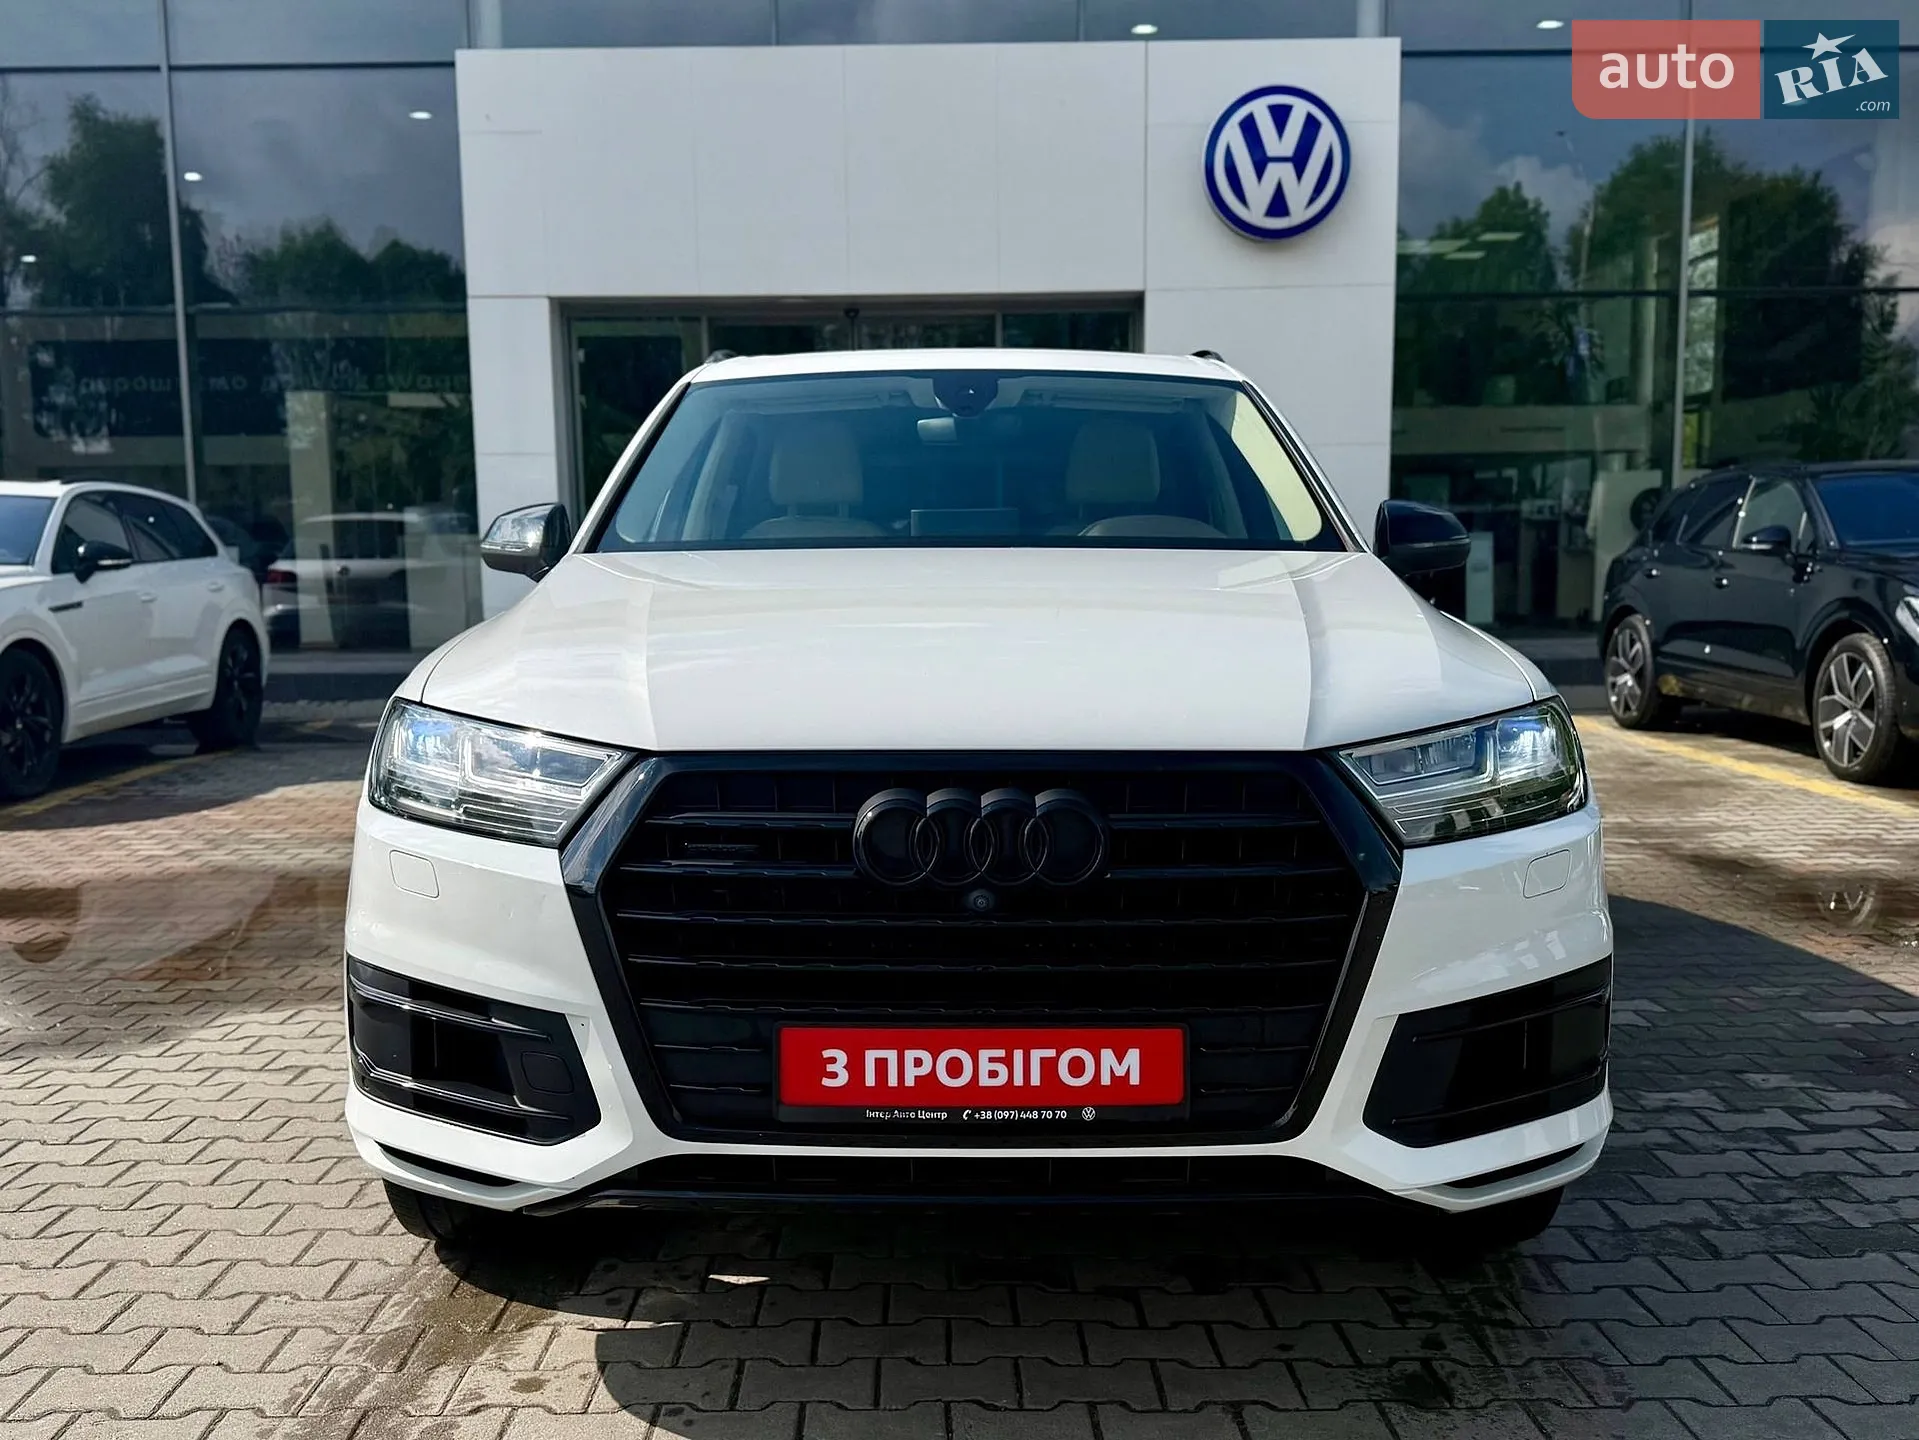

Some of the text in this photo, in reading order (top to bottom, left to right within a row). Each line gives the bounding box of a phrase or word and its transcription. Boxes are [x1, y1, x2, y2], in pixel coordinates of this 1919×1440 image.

[865, 1048, 1140, 1088] ПРОБІГОМ
[974, 1109, 1068, 1121] +38 (097) 448 70 70
